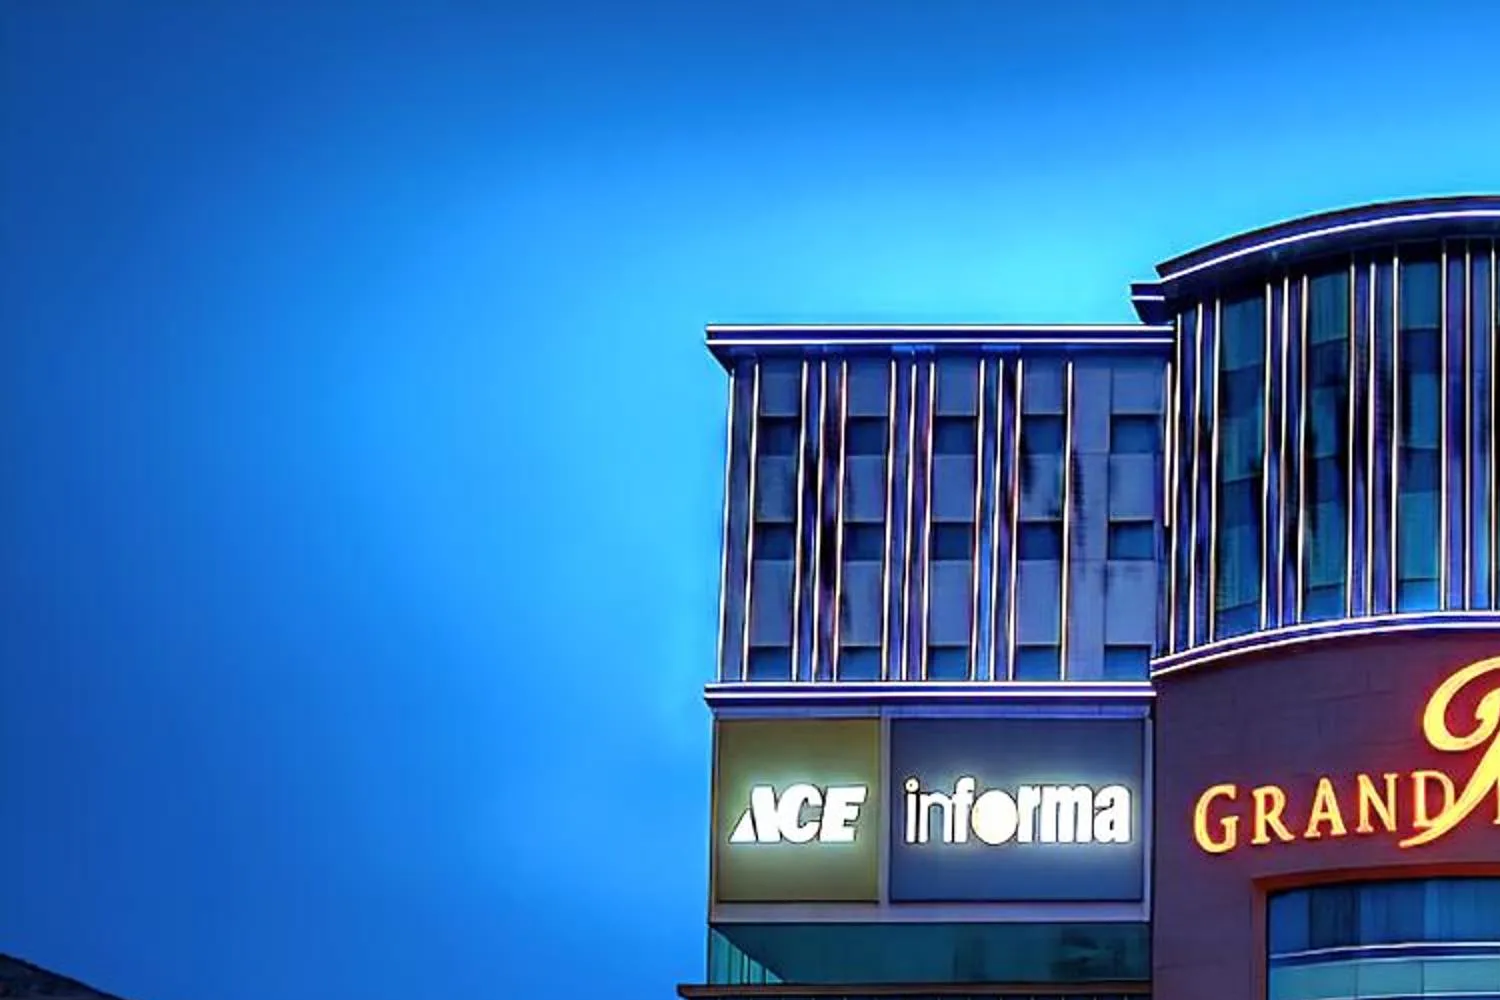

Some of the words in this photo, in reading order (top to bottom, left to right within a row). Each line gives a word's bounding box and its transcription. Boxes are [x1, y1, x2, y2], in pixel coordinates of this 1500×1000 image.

[728, 784, 868, 844] ACE
[904, 776, 1133, 845] informa
[1193, 769, 1457, 854] GRAND
